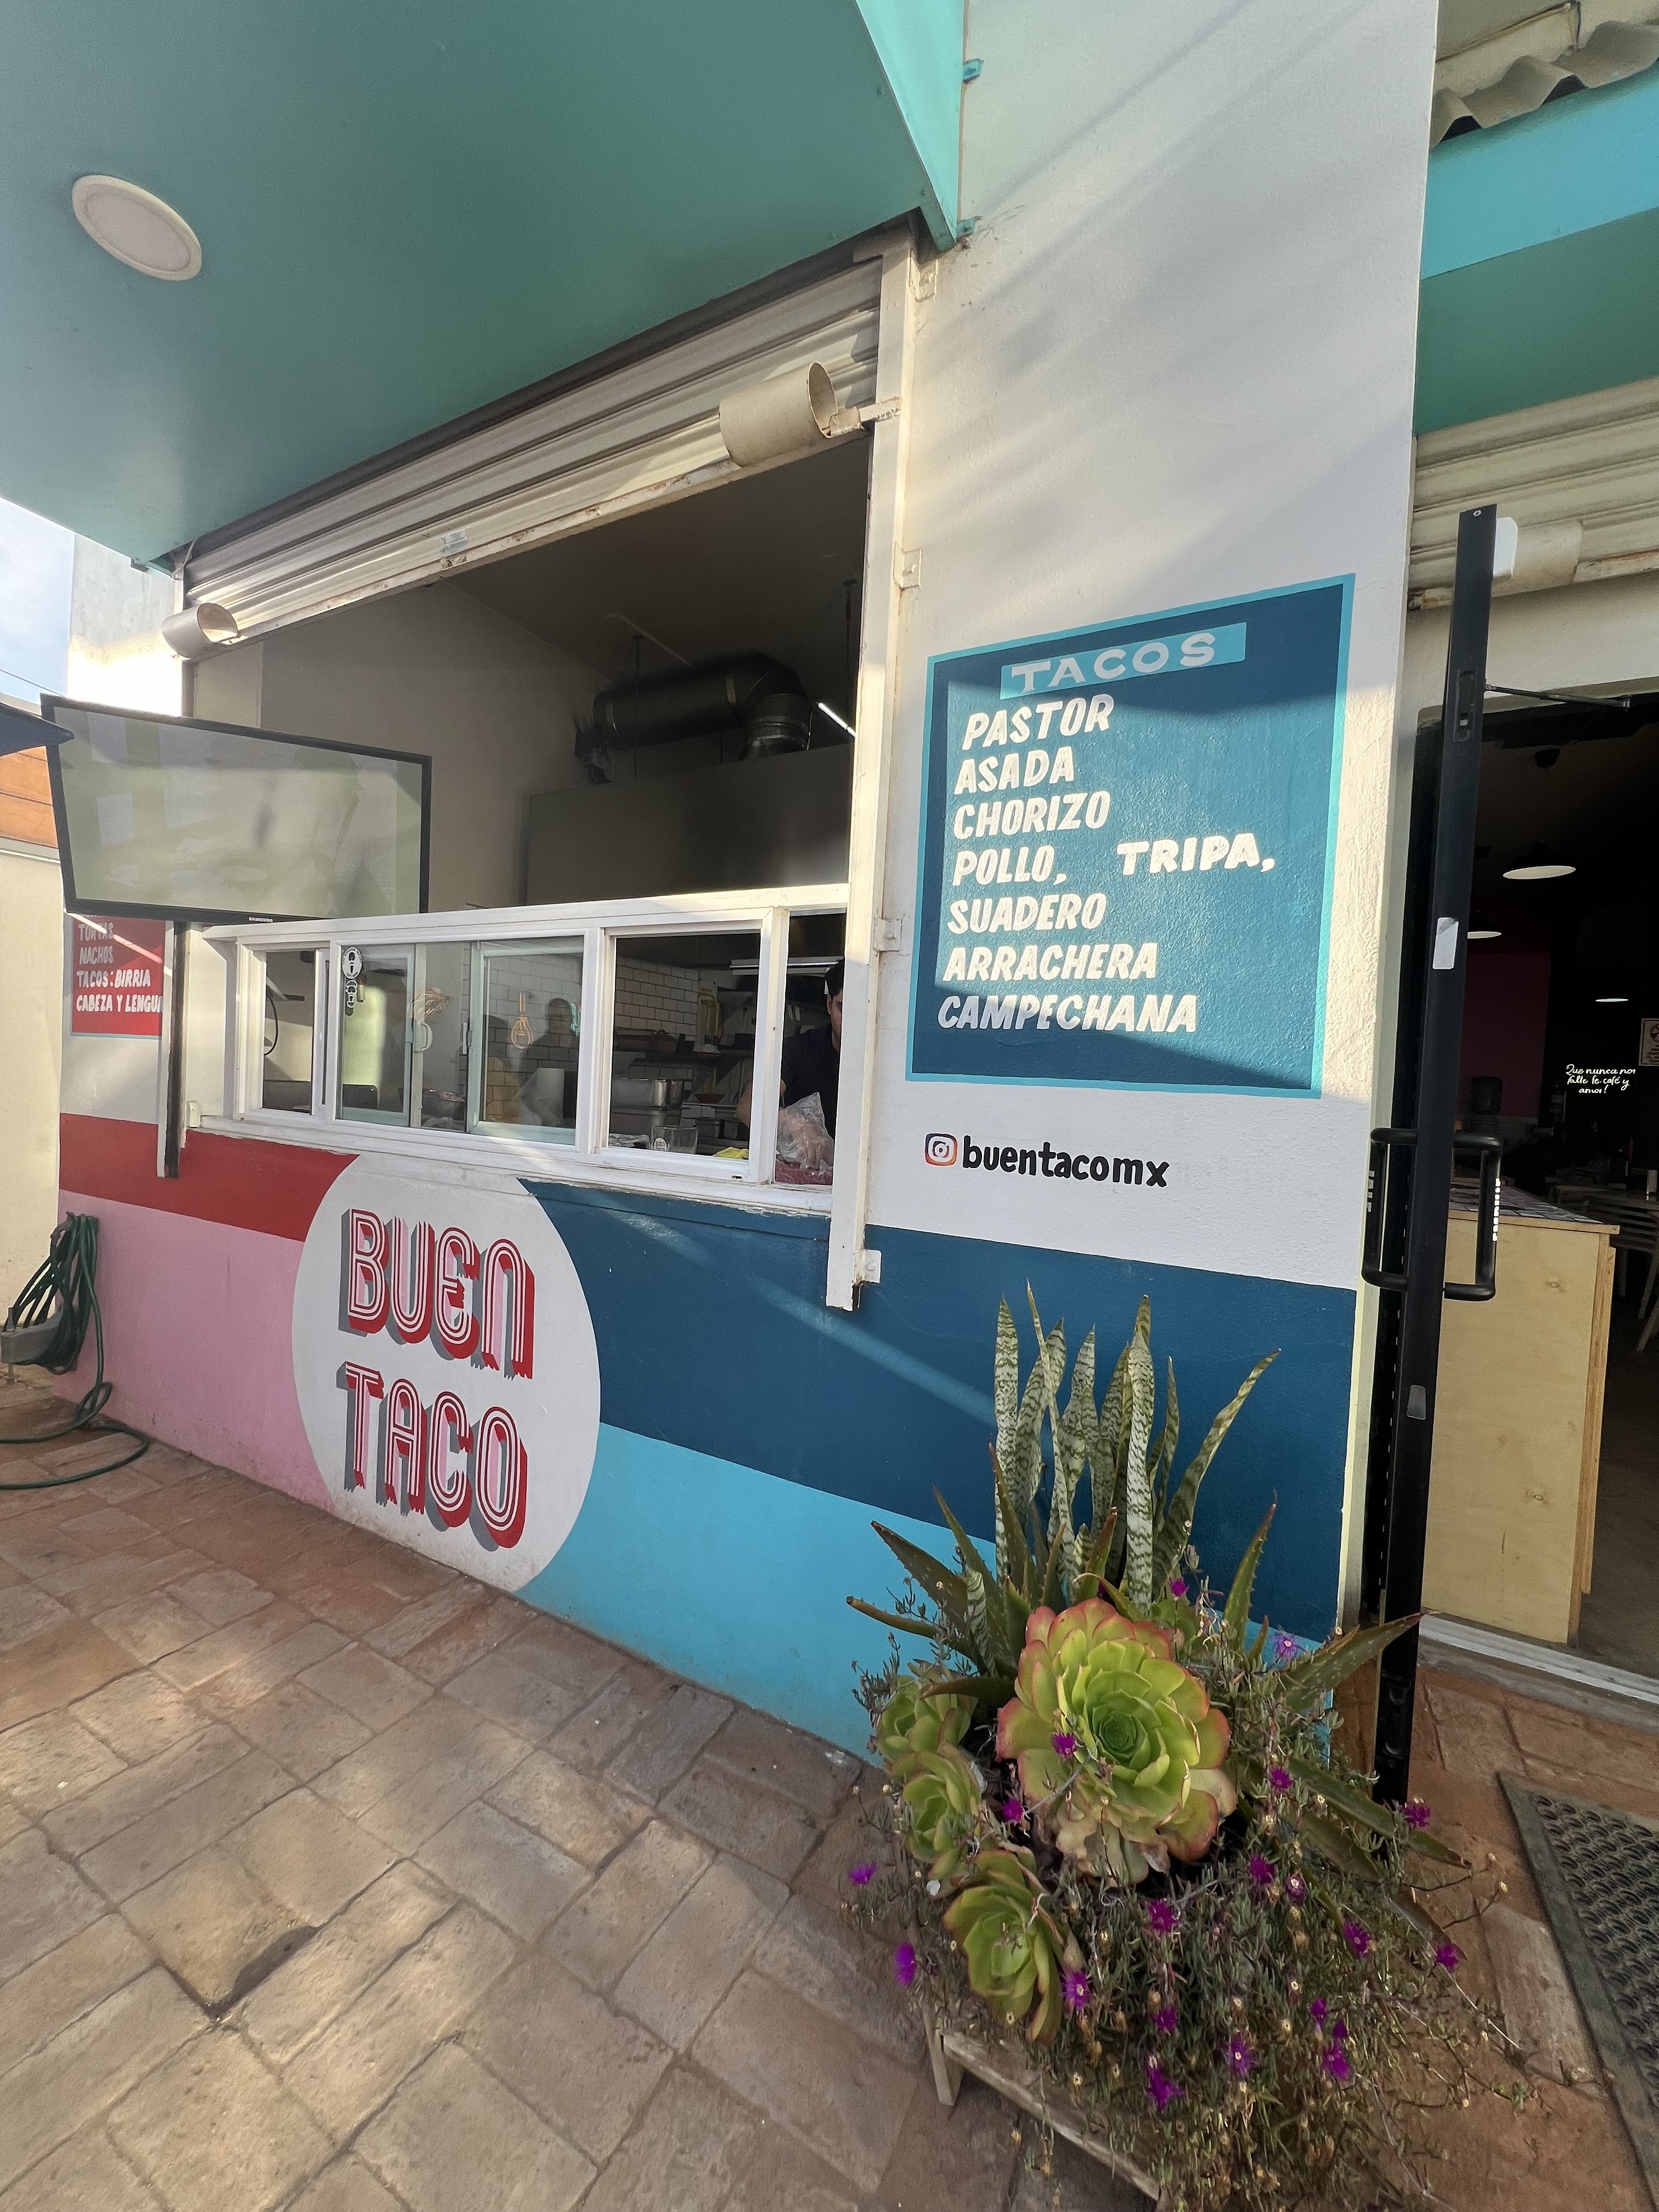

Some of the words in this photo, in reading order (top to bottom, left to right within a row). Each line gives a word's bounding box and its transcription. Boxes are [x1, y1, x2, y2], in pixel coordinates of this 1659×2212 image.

[1012, 633, 1216, 693] TACOS
[962, 694, 1114, 751] PASTOR
[953, 746, 1075, 795] ASADA
[953, 791, 1110, 840] CHORIZO
[953, 845, 1067, 886] POLLO,
[1117, 833, 1276, 876] TRIPA,
[947, 893, 1107, 934] SUADERO
[80, 946, 113, 964] NACHOS
[943, 943, 1158, 981] ARRACHERA
[76, 994, 112, 1012] CABEZA
[116, 994, 123, 1012] Y
[937, 994, 1197, 1033] CAMPECHANA
[1621, 1079, 1630, 1091] y
[963, 1135, 1170, 1187] buentacomx
[338, 1208, 535, 1380] BUEN
[336, 1361, 528, 1551] TACO
